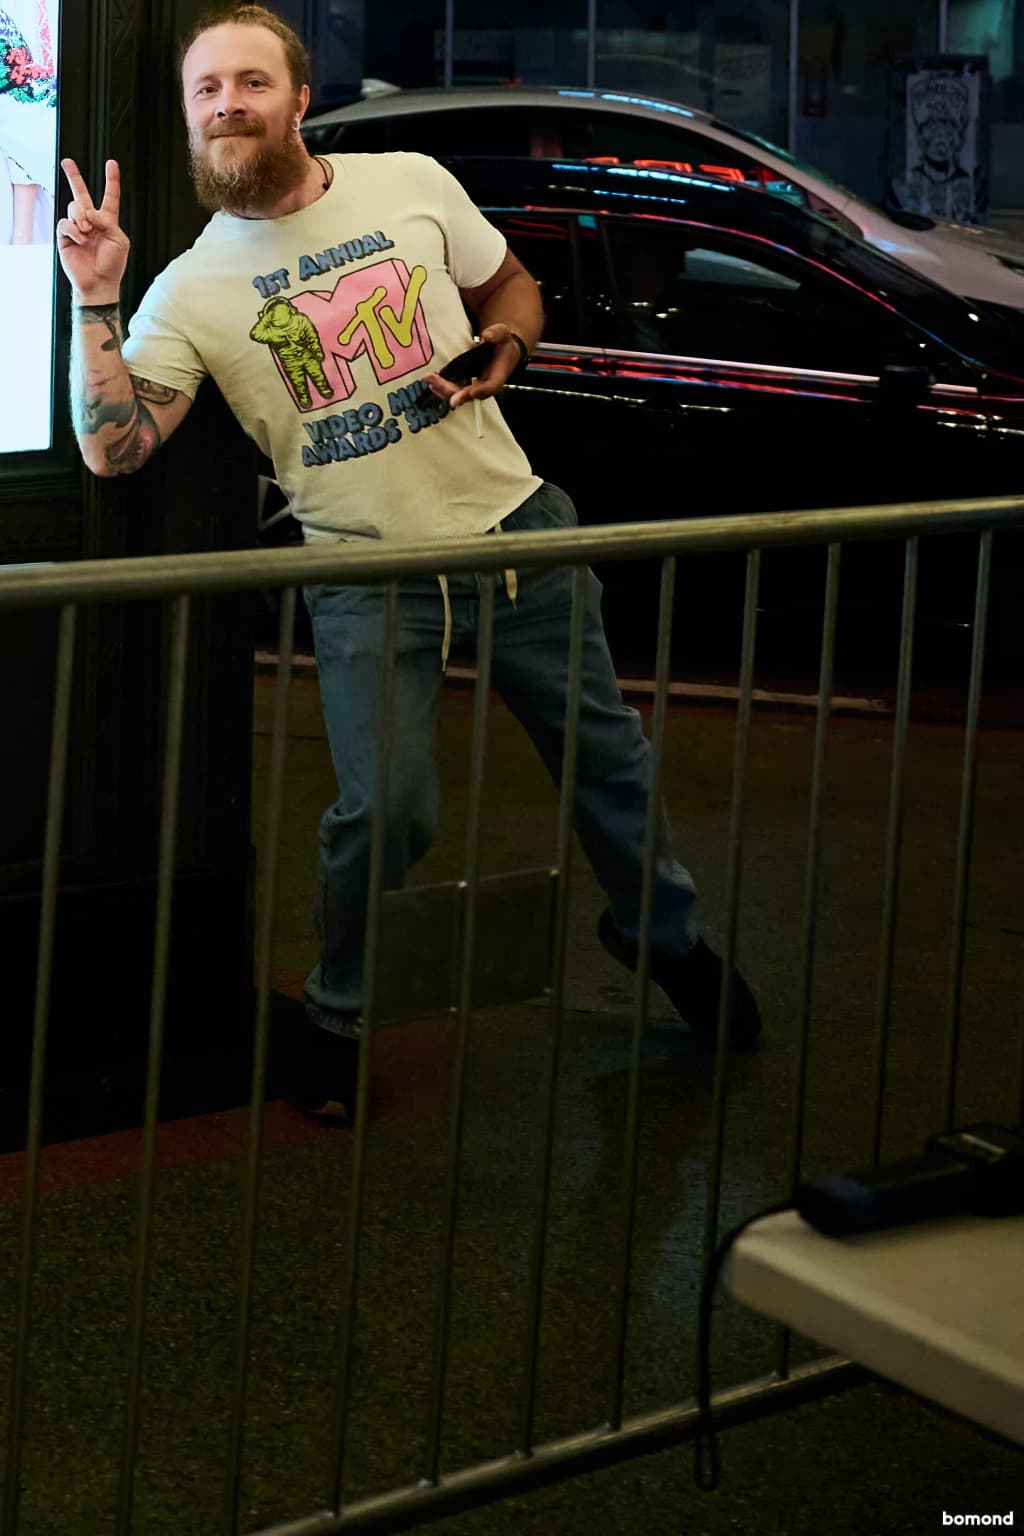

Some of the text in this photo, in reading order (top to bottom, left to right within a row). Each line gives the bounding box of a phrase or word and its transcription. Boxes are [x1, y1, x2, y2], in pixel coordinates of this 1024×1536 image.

[251, 230, 396, 300] 1ST ANNUAL
[301, 418, 403, 468] AWARDS
[302, 401, 384, 444] VIDEO
